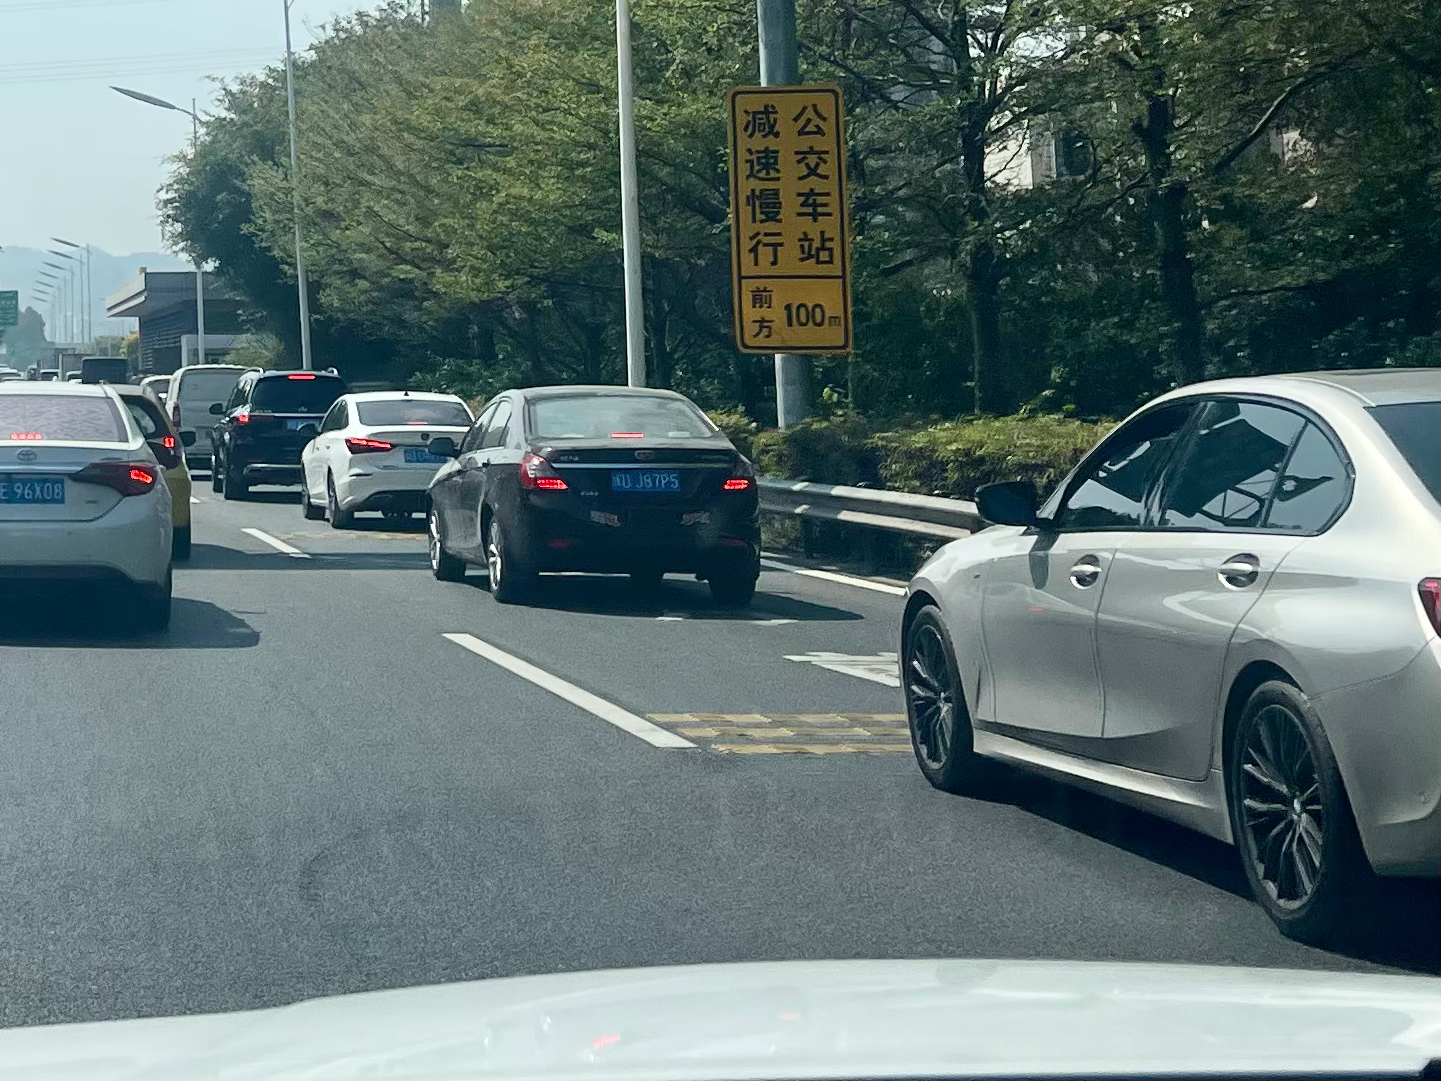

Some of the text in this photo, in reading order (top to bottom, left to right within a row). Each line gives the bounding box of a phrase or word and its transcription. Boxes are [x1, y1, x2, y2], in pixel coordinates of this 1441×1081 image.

[743, 104, 785, 267] 减速慢行
[792, 103, 835, 266] 公交车站
[750, 286, 775, 339] 前方
